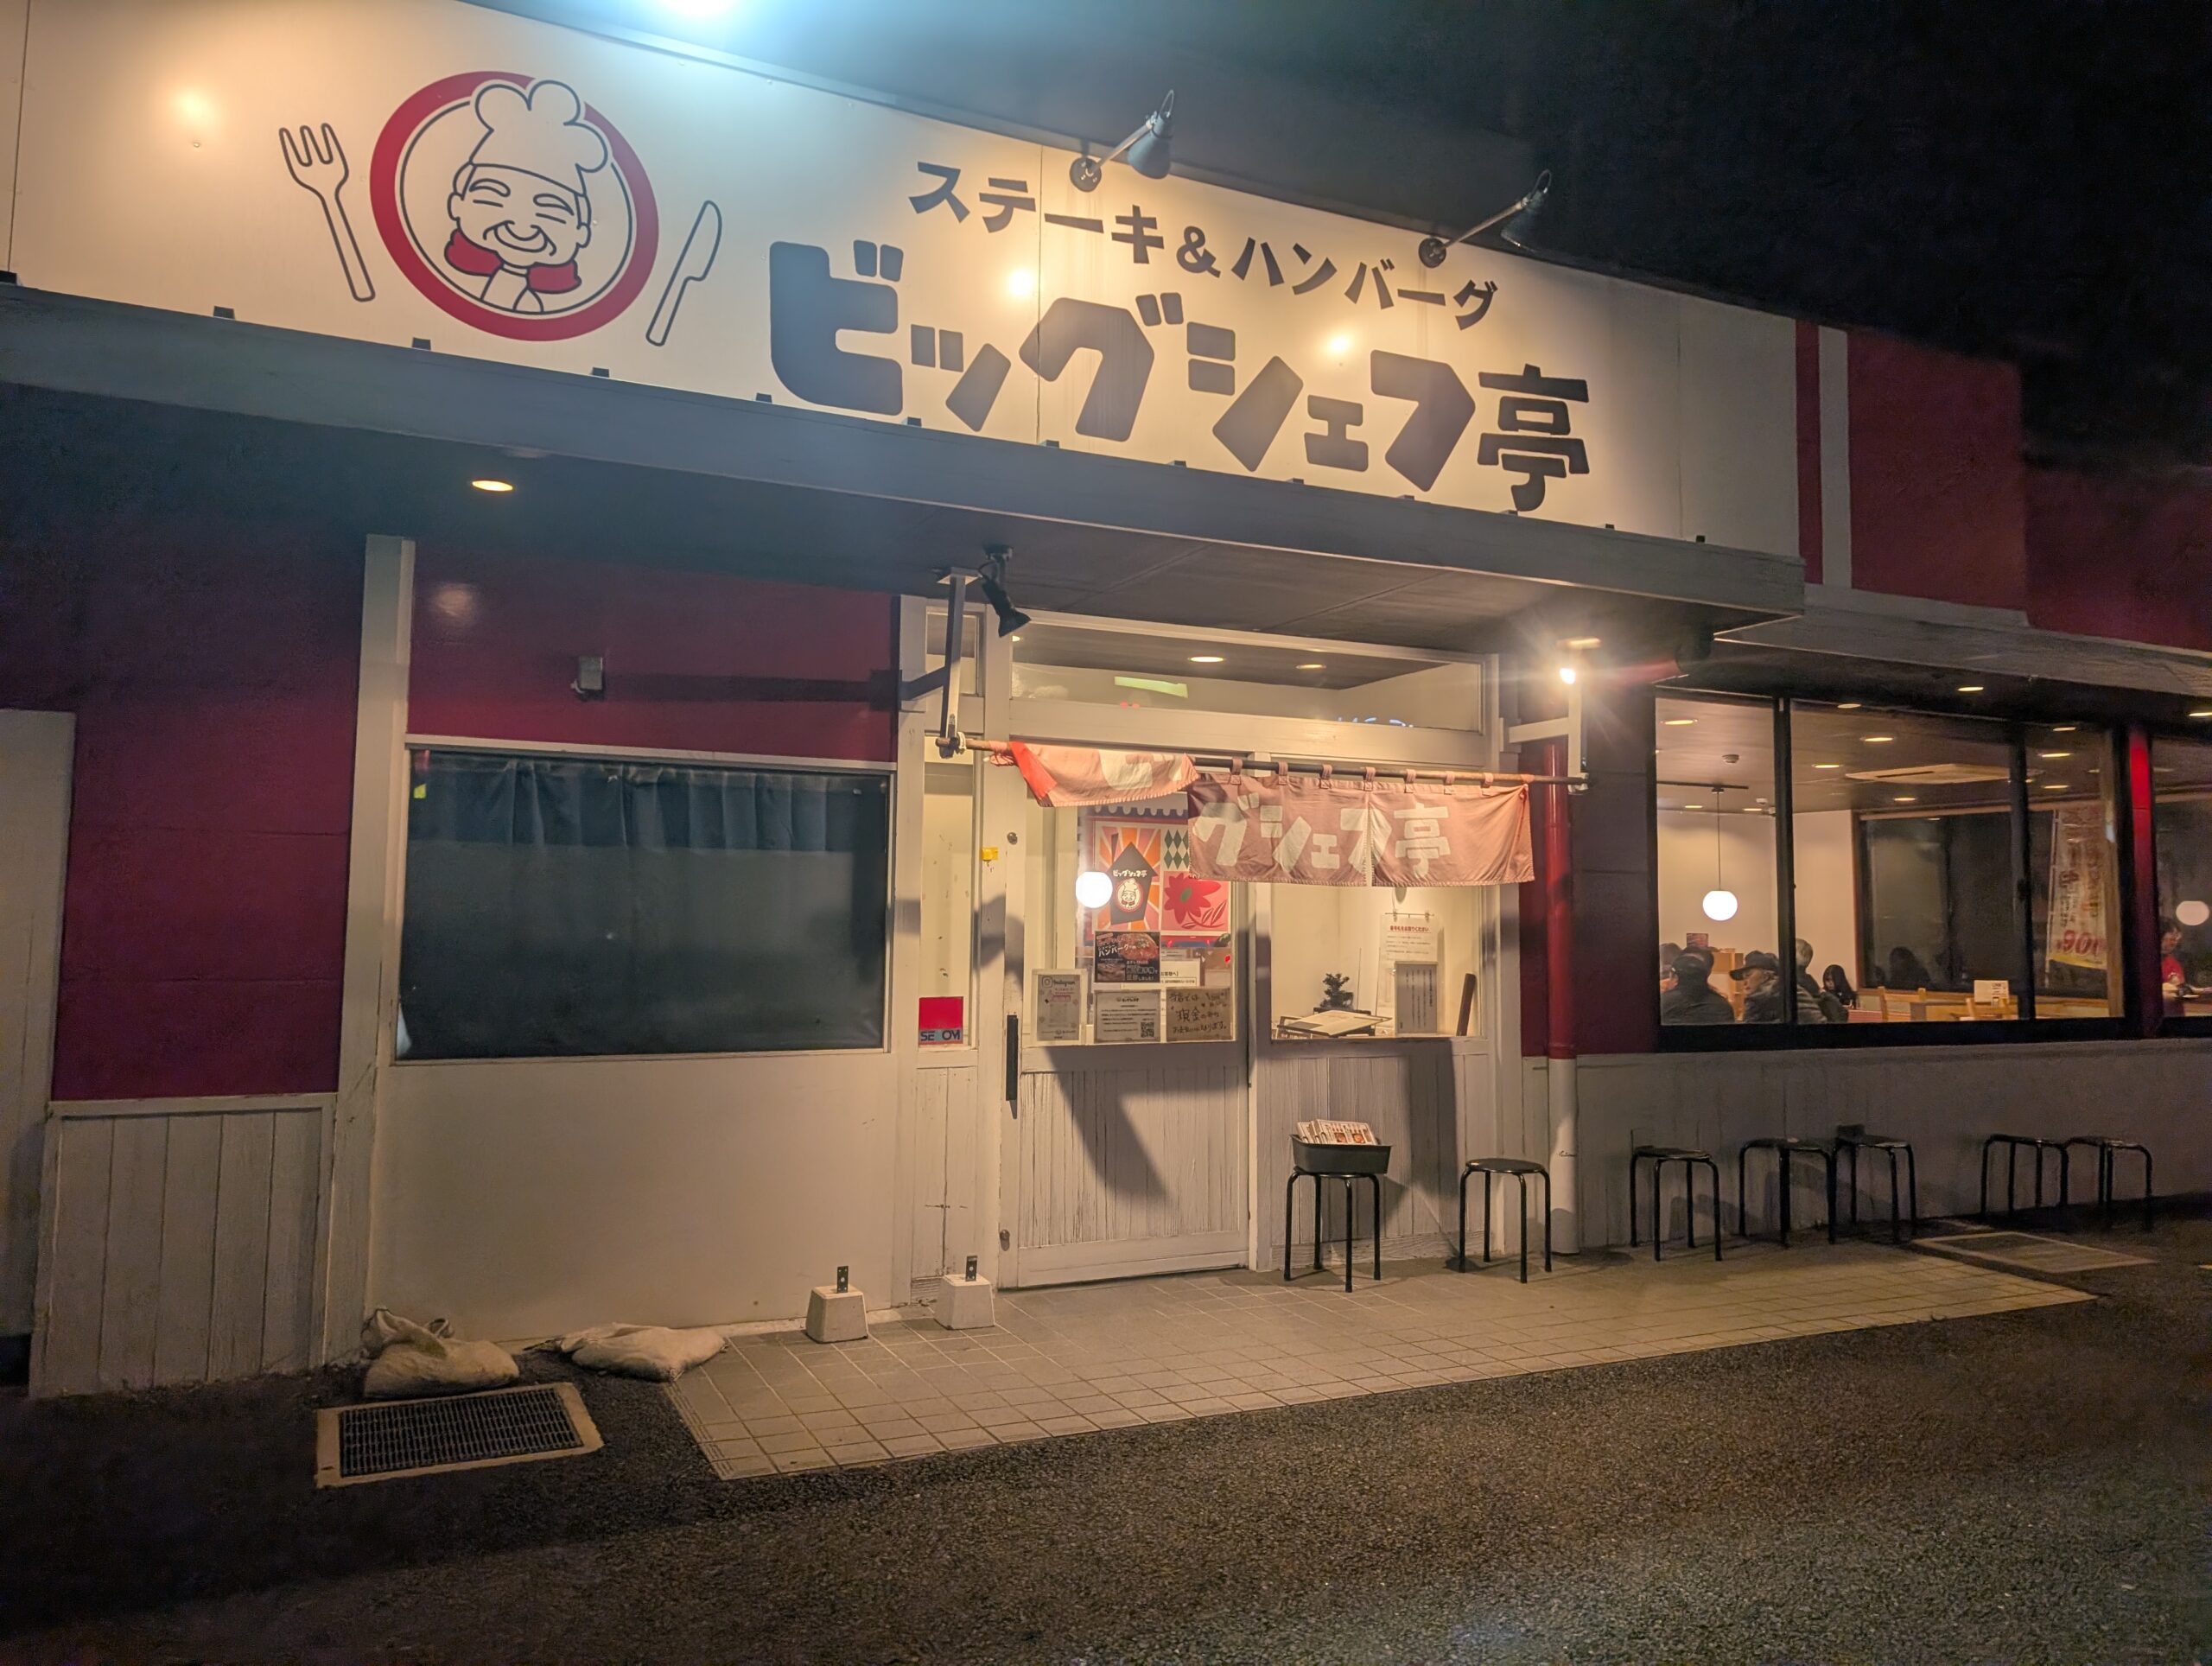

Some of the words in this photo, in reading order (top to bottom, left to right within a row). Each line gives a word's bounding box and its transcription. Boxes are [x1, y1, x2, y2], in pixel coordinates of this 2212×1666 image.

[908, 161, 1498, 331] ステーキ&ハンバーグ
[769, 240, 1590, 512] ビッグシェフ亭
